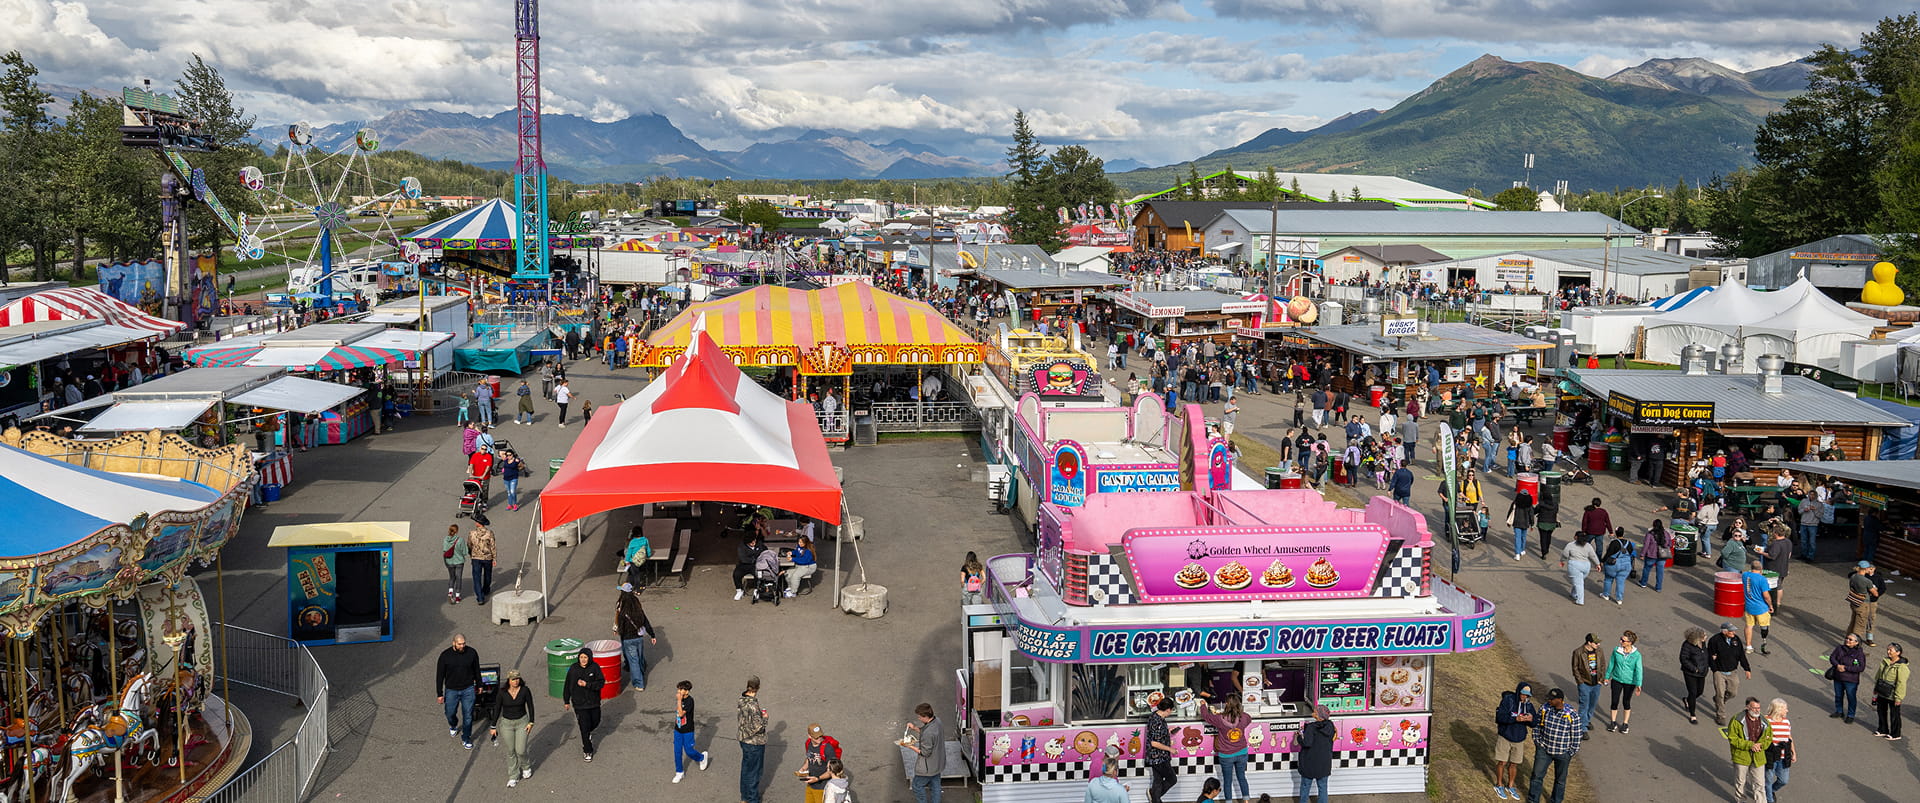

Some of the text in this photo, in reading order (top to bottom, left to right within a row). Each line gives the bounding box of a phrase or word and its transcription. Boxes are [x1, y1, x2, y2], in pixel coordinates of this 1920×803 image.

[1151, 308, 1185, 316] LEMONADE
[1387, 327, 1416, 335] BURGER
[1641, 408, 1661, 417] Corn
[1663, 408, 1681, 419] Dog
[1682, 408, 1712, 419] Corner
[1101, 474, 1135, 486] CANDY
[1209, 545, 1331, 556] Golden Wheel Amusements
[1477, 616, 1495, 628] FRU
[1055, 633, 1065, 642] &
[1093, 628, 1270, 656] ICE CREAM CONES
[1277, 624, 1448, 651] ROOT BEER FLOATS
[1471, 632, 1495, 646] TOPP
[1019, 641, 1073, 658] OPPINGS
